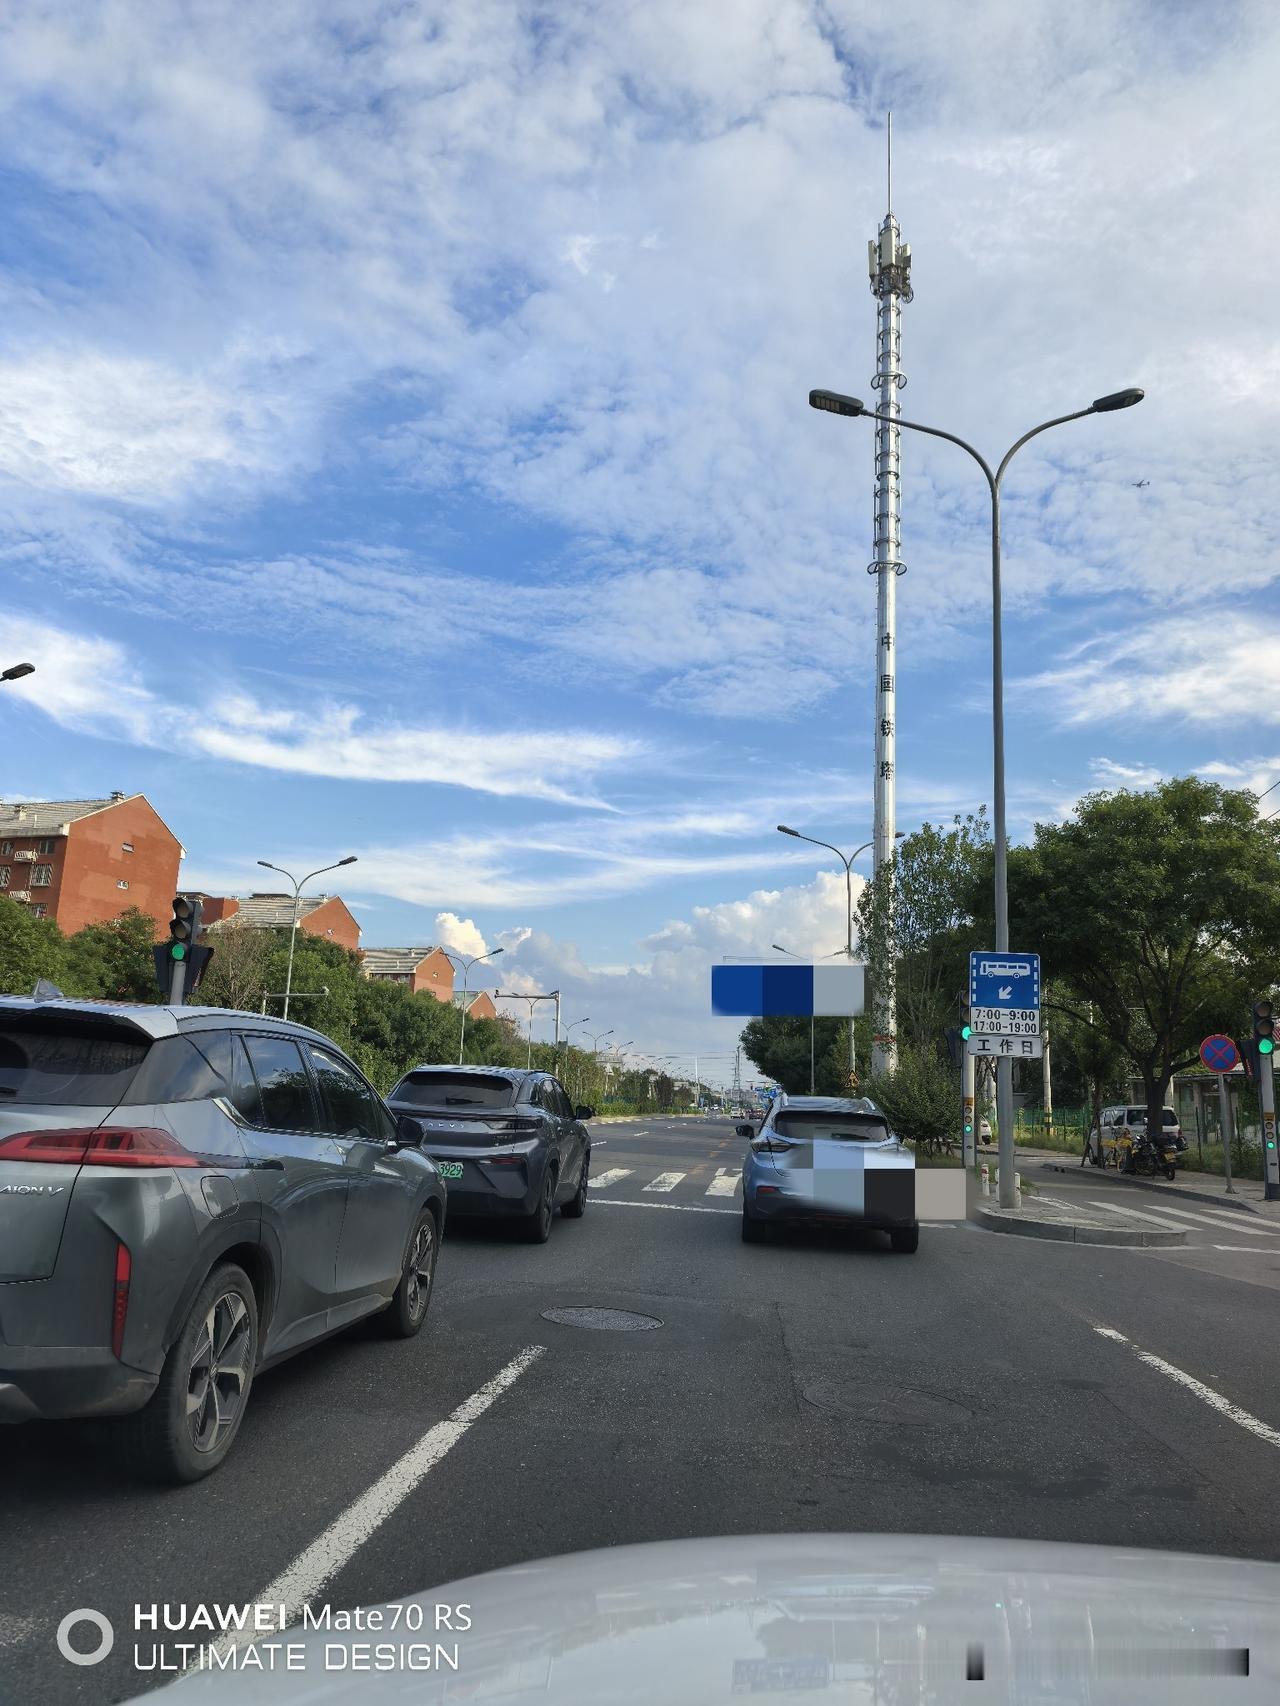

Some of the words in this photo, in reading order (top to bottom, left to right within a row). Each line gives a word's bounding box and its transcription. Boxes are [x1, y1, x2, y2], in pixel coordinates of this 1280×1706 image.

[880, 632, 895, 781] 中国铁塔
[975, 1008, 1035, 1022] 7:00-9:00
[973, 1020, 1037, 1034] 17:00-19:00
[976, 1038, 1033, 1055] 工作日
[0, 1184, 44, 1195] AION
